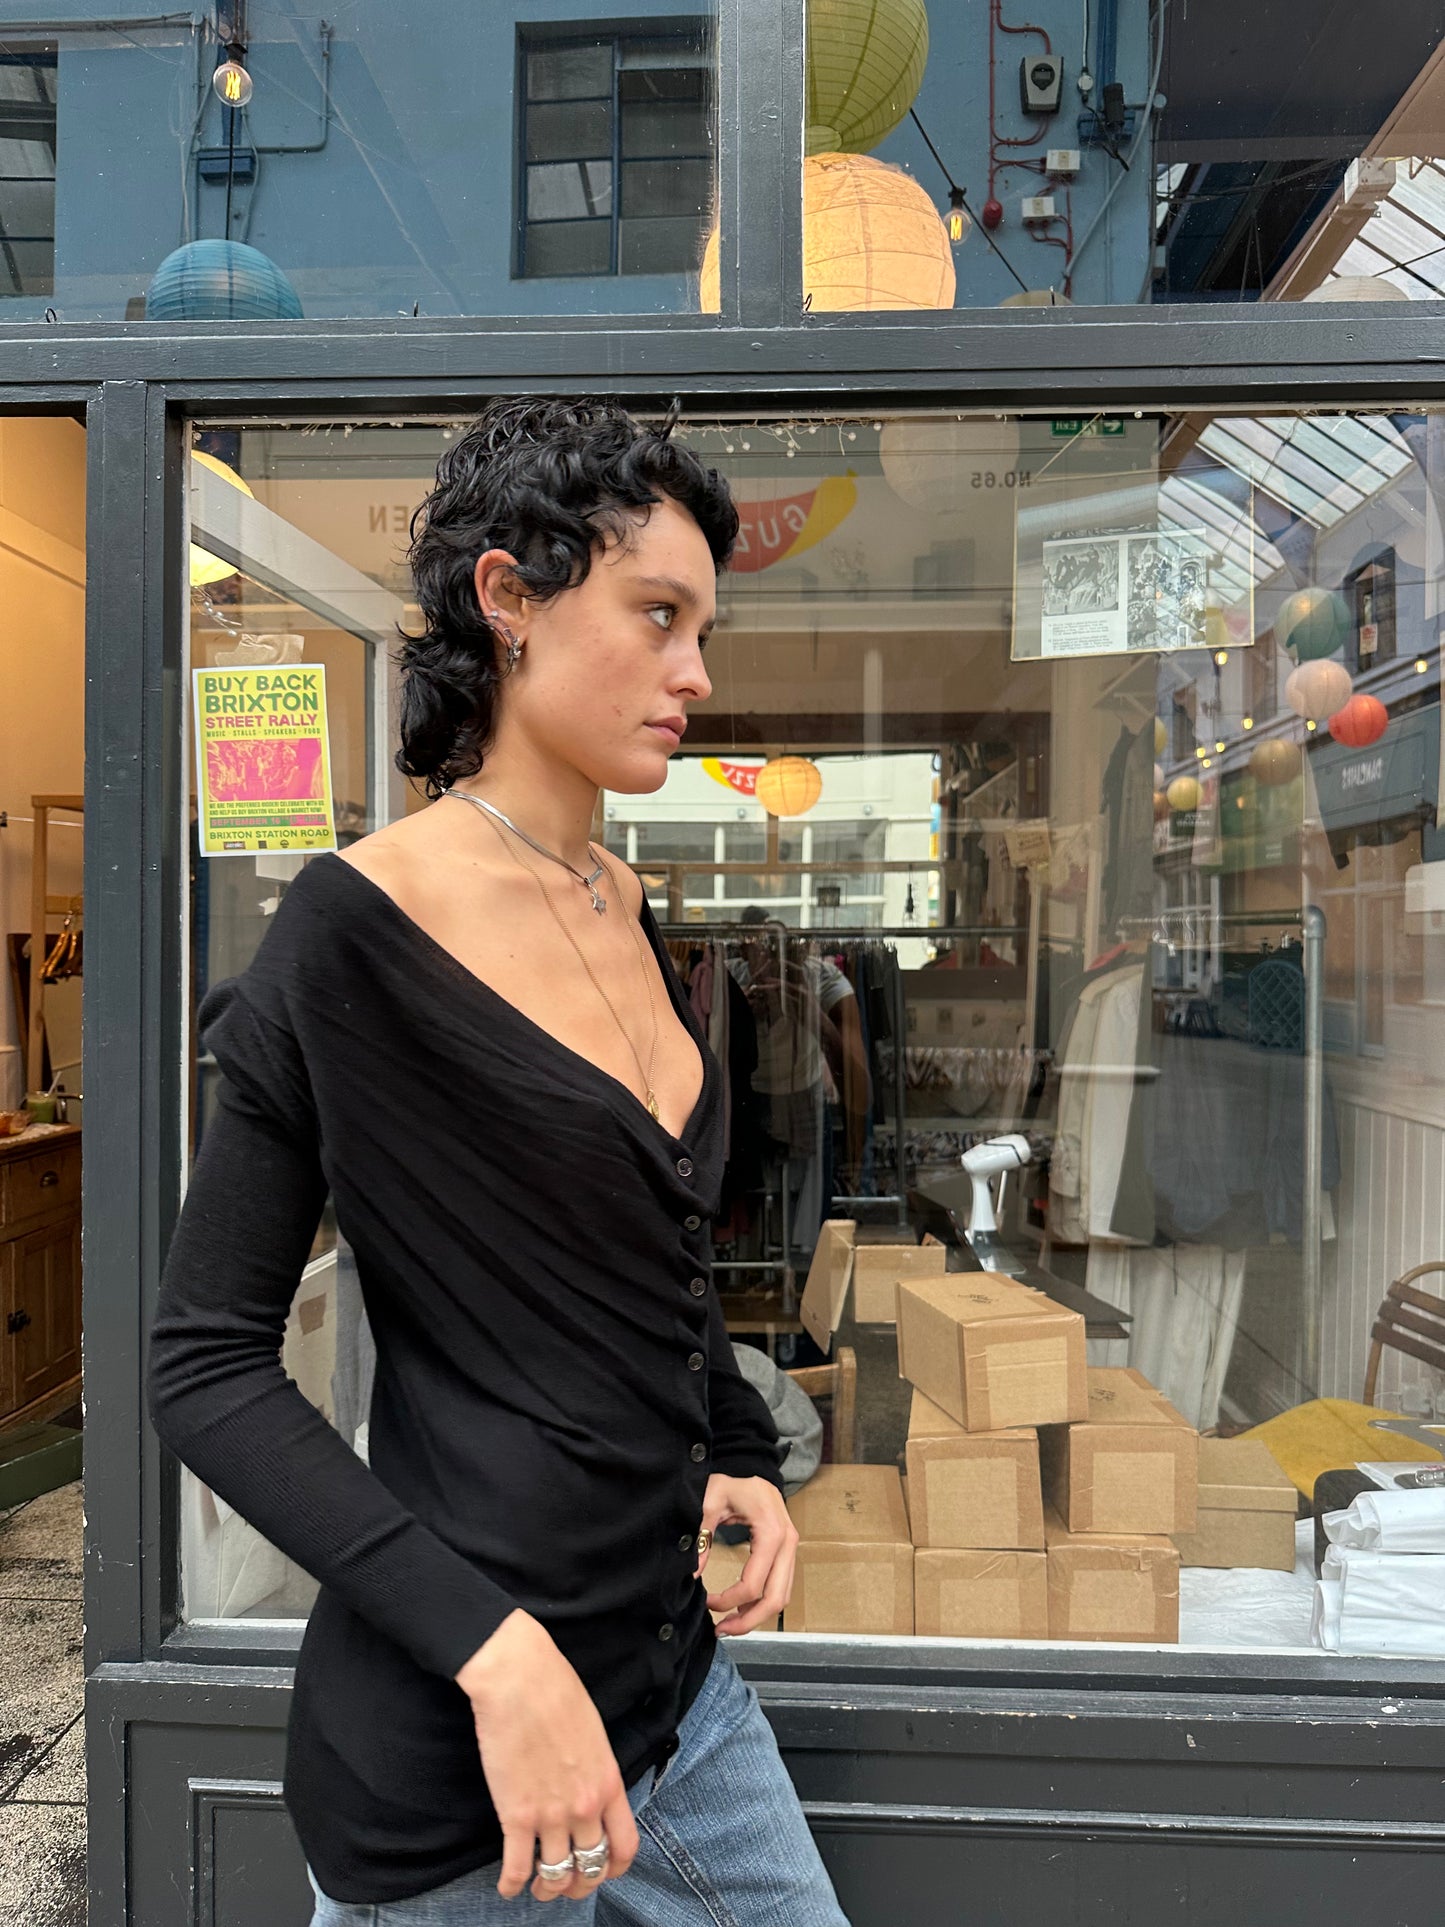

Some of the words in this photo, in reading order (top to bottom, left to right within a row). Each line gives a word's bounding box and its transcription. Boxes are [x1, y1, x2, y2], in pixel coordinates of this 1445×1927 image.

[205, 676, 249, 693] BUY
[256, 673, 317, 691] BACK
[205, 692, 319, 713] BRIXTON
[205, 714, 264, 729] STREET
[269, 713, 318, 727] RALLY
[206, 730, 226, 738] MUSIC
[233, 729, 257, 737] STALLS
[263, 728, 297, 736] SPEAKERS
[303, 727, 321, 735] FOOD
[211, 816, 268, 827] SEPTEMBER
[210, 830, 253, 840] BRIXTON
[255, 829, 298, 839] STATION
[300, 828, 329, 837] ROAD
